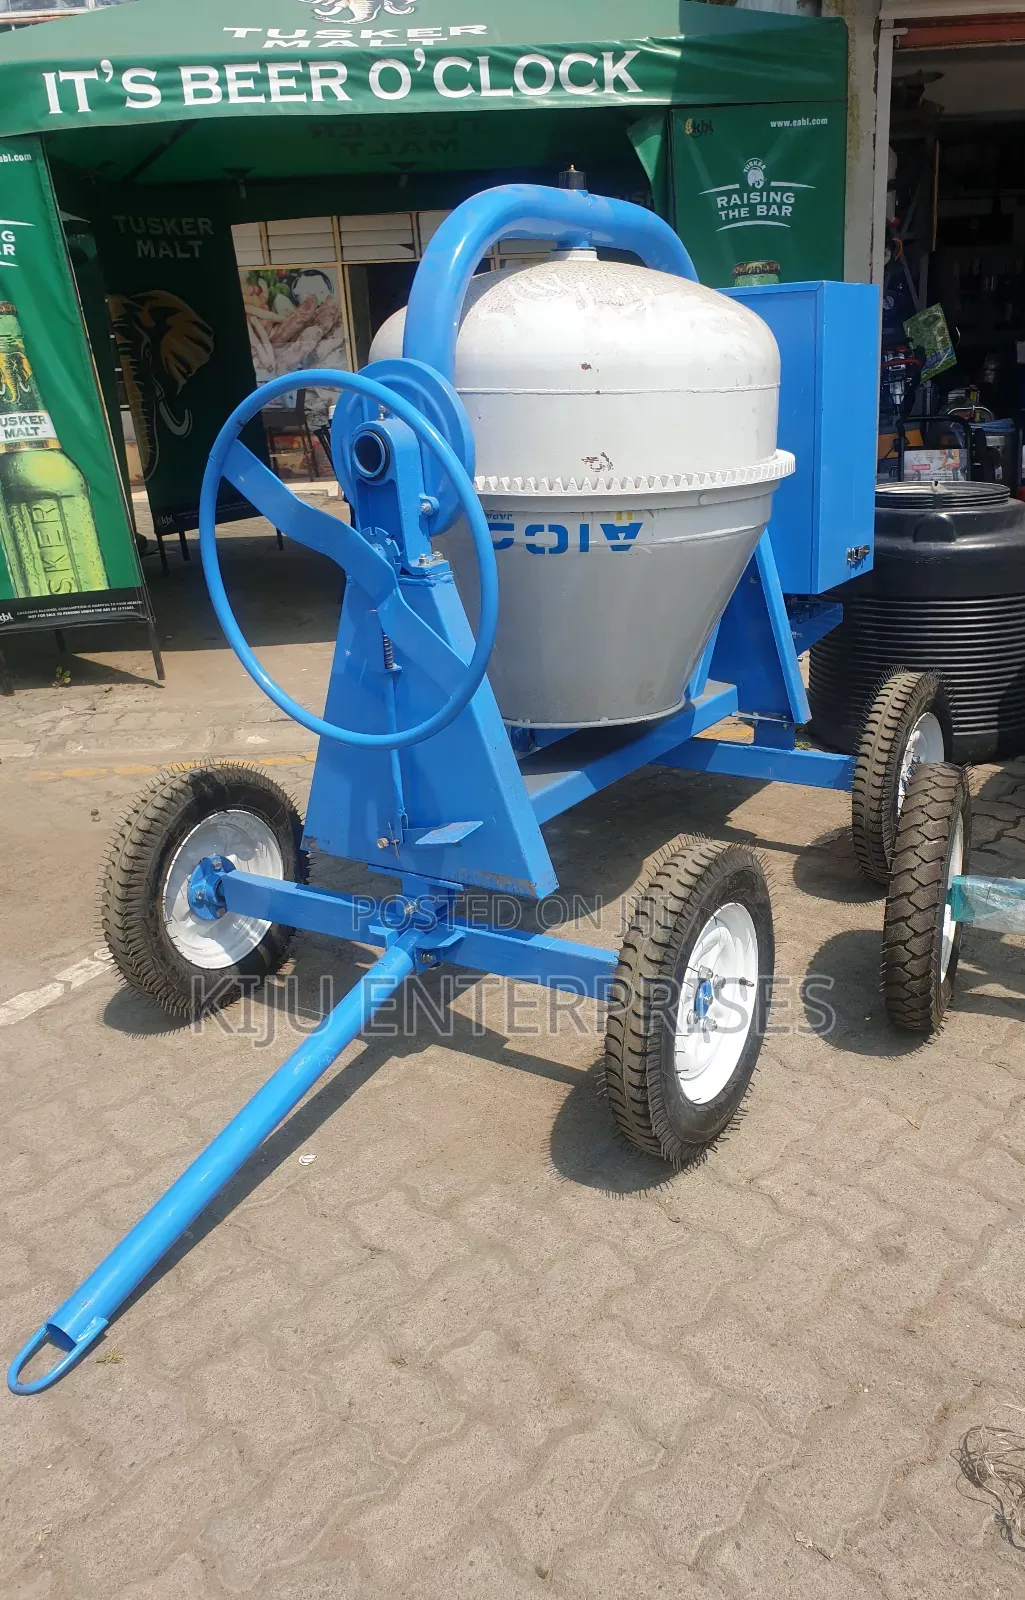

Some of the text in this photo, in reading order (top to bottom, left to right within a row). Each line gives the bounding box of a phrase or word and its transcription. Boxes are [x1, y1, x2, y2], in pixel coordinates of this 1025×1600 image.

[223, 25, 488, 39] TUSKER
[263, 37, 447, 49] MALT
[42, 48, 643, 115] IT'S BEER O'CLOCK
[770, 117, 828, 128] www.eabl.com
[743, 160, 766, 173] TUSKER
[716, 191, 796, 209] RAISING
[719, 204, 793, 221] THE BAR
[112, 215, 215, 236] TUSKER
[136, 239, 203, 259] MALT
[4, 427, 40, 439] MALT
[485, 512, 513, 521] JAPA
